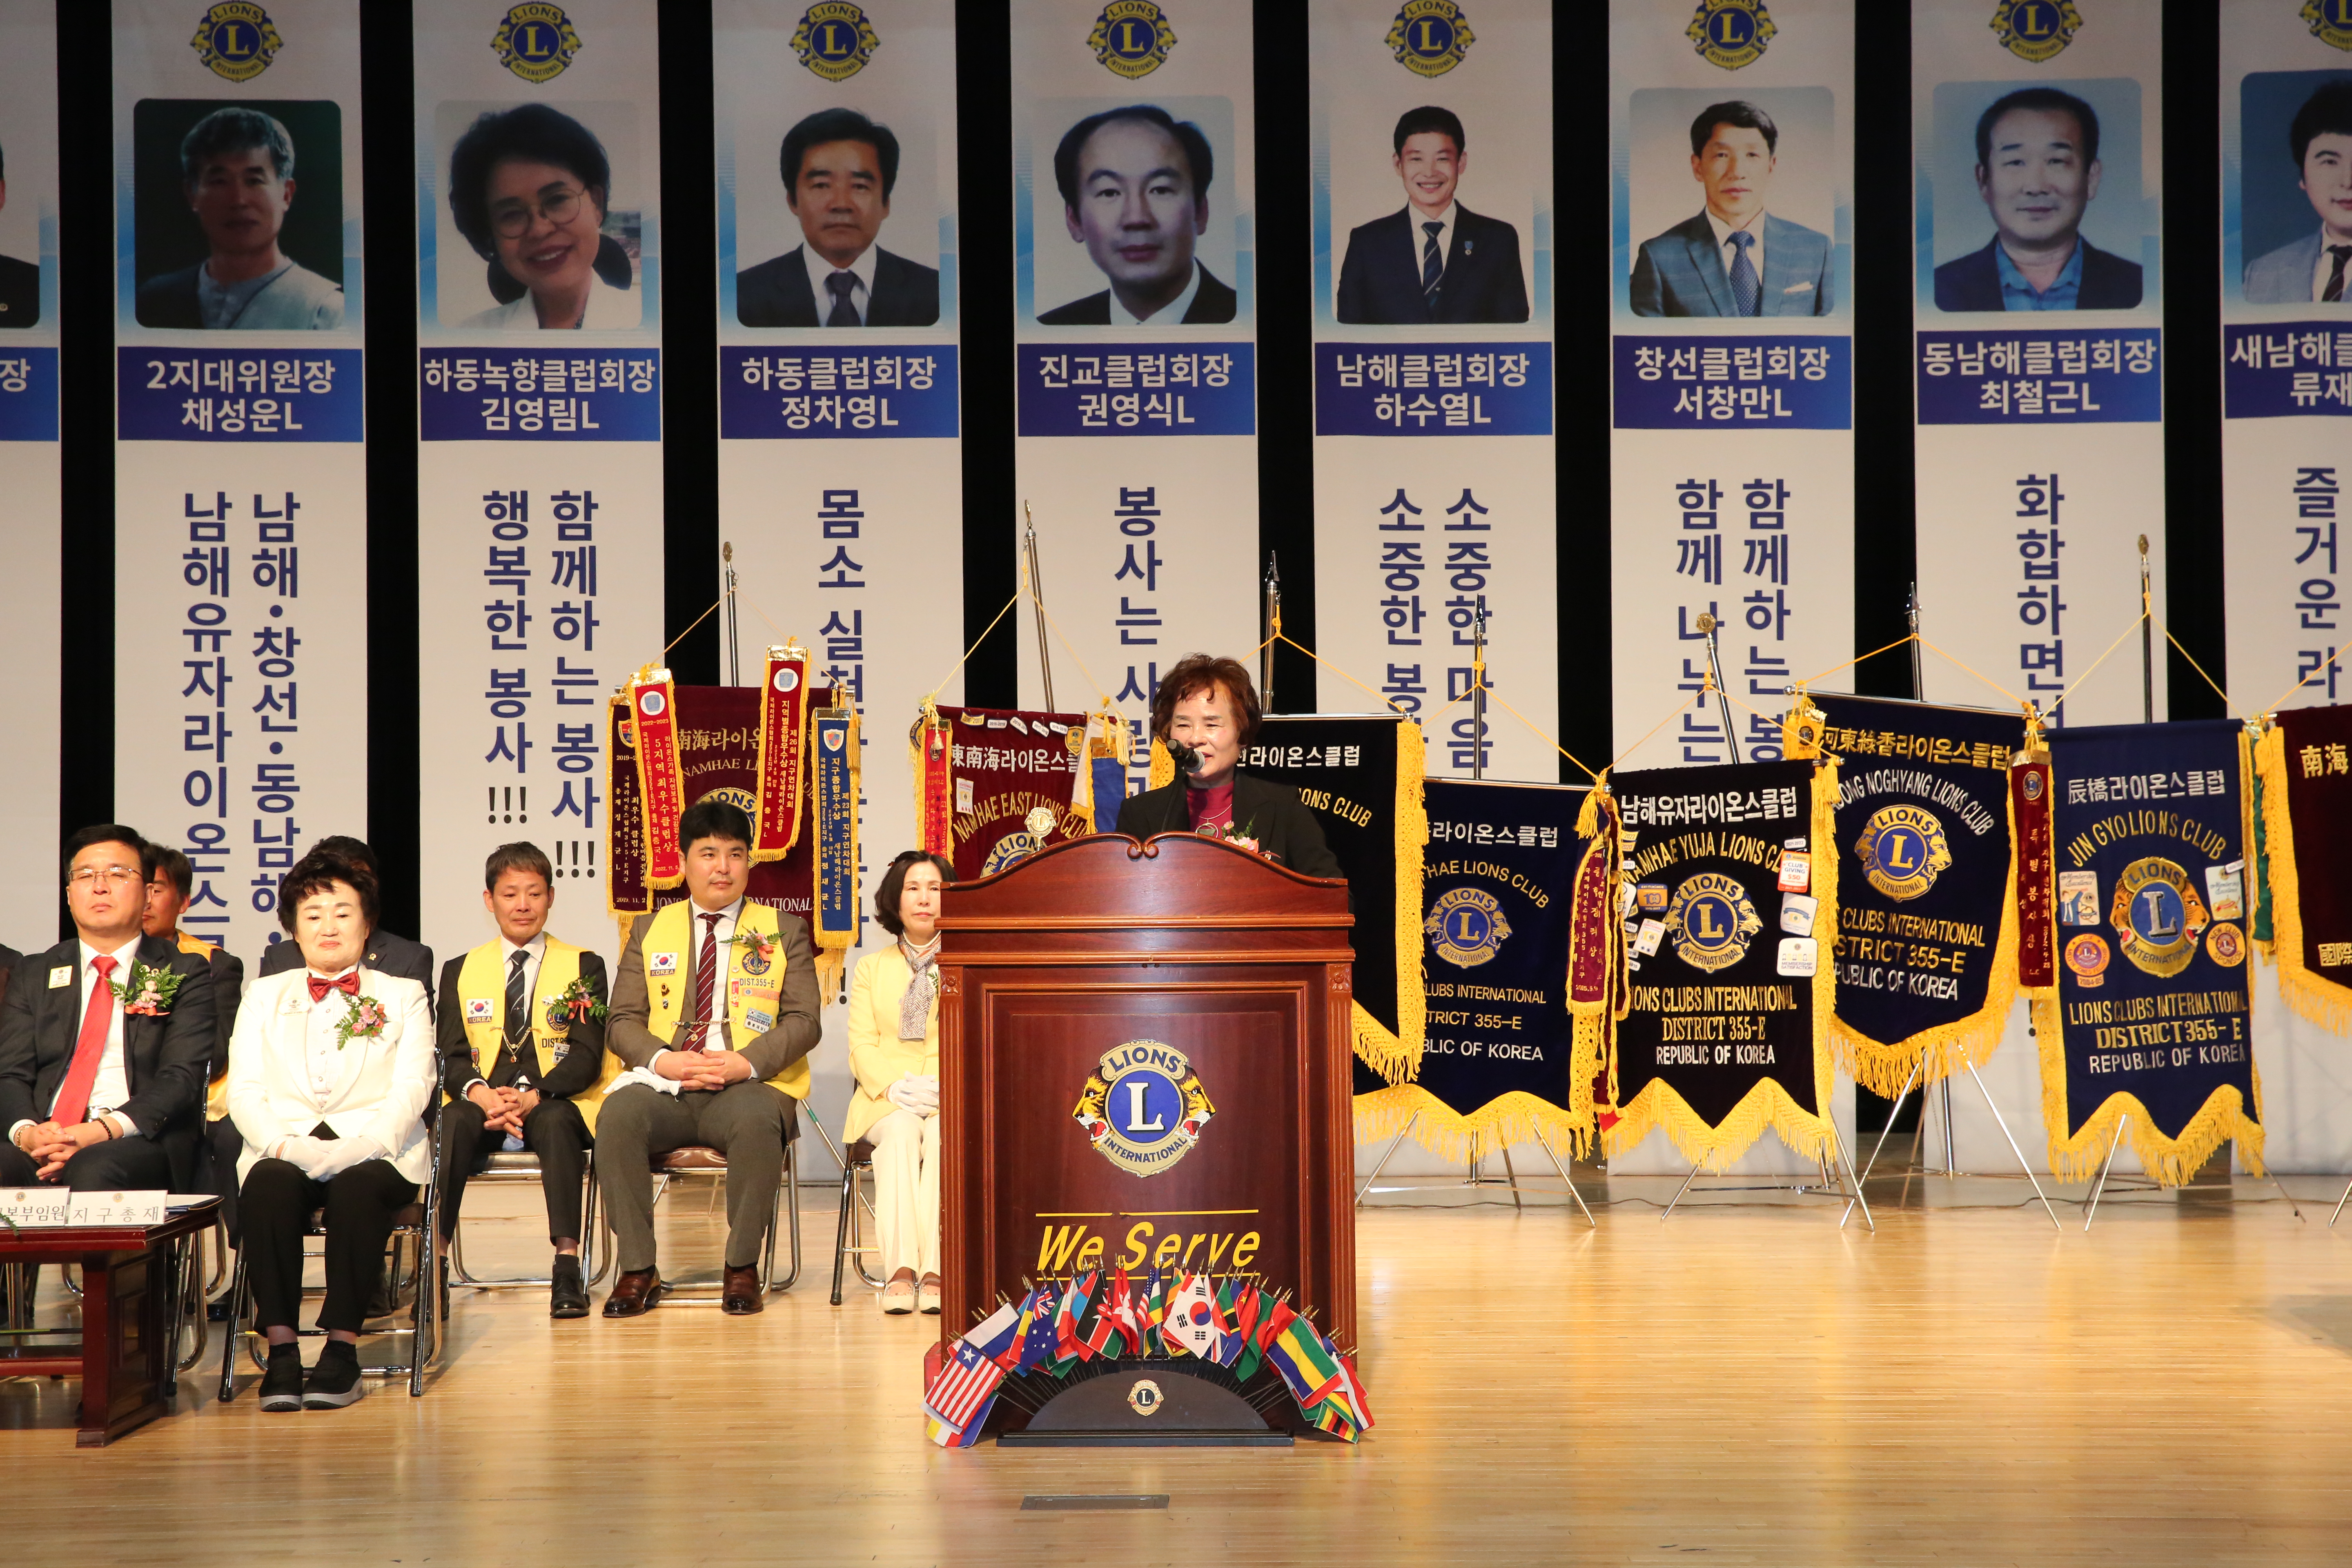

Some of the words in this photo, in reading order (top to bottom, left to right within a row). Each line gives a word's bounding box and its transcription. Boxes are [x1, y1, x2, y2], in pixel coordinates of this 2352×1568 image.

[213, 5, 260, 20] LIONS
[513, 6, 559, 21] LIONS
[812, 4, 857, 21] LIONS
[1109, 3, 1154, 19] LIONS
[1408, 1, 1453, 16] LIONS
[2025, 5, 2049, 35] L
[225, 25, 249, 55] L
[525, 27, 548, 56] L
[823, 25, 847, 55] L
[1120, 24, 1144, 52] L
[1419, 21, 1443, 51] L
[1720, 13, 1744, 42] L
[213, 60, 261, 76] INTERNATIONAL
[513, 62, 560, 76] INTERNATIONAL
[813, 60, 859, 76] INTERNATIONAL
[1110, 58, 1156, 74] INTERNATIONAL
[1408, 56, 1454, 72] INTERNATIONAL
[742, 356, 936, 390] 하동클럽회장
[1040, 354, 1233, 388] 진교클럽회장
[1337, 354, 1530, 388] 남해클럽회장
[1635, 347, 1831, 381] 창선클럽회장
[1923, 339, 2156, 376] 동남해클럽회장
[147, 360, 335, 393] 2지대위원장
[425, 360, 656, 394] 하동녹향클럽회장
[2290, 372, 2352, 407] 류재
[781, 394, 899, 428] 정차영L
[1078, 393, 1195, 427] 권영식L
[1374, 392, 1492, 426] 하수열L
[1673, 386, 1793, 420] 서창만L
[1980, 380, 2100, 414] 최철근L
[182, 399, 303, 432] 채성운L
[481, 398, 599, 432] 김영림L
[817, 490, 865, 588] 몸소
[1675, 479, 1724, 585] 함께
[2293, 467, 2341, 629] 즐거운
[483, 490, 532, 650] 행복한
[1114, 486, 1163, 645] 봉사는
[1379, 488, 1426, 646] 소중한
[1444, 488, 1492, 646] 소중한
[550, 490, 600, 705] 함께하는
[1742, 479, 1791, 695] 함께하는
[1677, 601, 1725, 763] 나누는
[1447, 664, 1494, 769] 마음
[780, 700, 790, 768] 지역별종합우수상
[789, 729, 797, 755] 제26회
[654, 739, 665, 773] 5지역
[684, 758, 740, 779] NAMHAE
[2300, 743, 2349, 778] 南海
[786, 760, 796, 808] 지구연차대회
[831, 757, 841, 820] 지구종합우수상
[2068, 769, 2226, 805] 辰橋라이온스클럽
[631, 797, 639, 824] 최우수
[657, 777, 673, 852] 최우수클럽상
[1001, 791, 1032, 817] EAST
[1333, 797, 1372, 828] CLUB
[1621, 786, 1797, 826] 남해유자라이온스클럽
[1866, 768, 1933, 799] NOGHYANG
[1931, 778, 1969, 813] LIONS
[1960, 800, 1995, 836] CLUB
[1036, 815, 1045, 828] L
[1877, 809, 1934, 831] LIONS
[630, 830, 639, 857] 클럽상
[842, 823, 851, 876] 지구연차대회
[1889, 834, 1914, 869] L
[2067, 832, 2097, 867] JIN
[2092, 814, 2127, 846] GYO
[2128, 809, 2179, 838] LIONS
[2181, 818, 2227, 860] CLUB
[1622, 838, 1678, 884] NAMHAE
[1678, 832, 1715, 860] YUJA
[1719, 832, 1765, 865] LIONS
[1464, 860, 1510, 882] LIONS
[1512, 874, 1550, 908] CLUB
[1684, 875, 1738, 898] LIONS
[1872, 873, 1925, 894] INTERNATIONAL
[2127, 863, 2182, 888] LIONS
[1447, 890, 1494, 908] LIONS
[2142, 891, 2178, 938] L
[1457, 912, 1479, 940] L
[1697, 904, 1724, 938] L
[1842, 907, 1885, 933] CLUBS
[1888, 912, 1986, 948] INTERNATIONAL
[2209, 927, 2222, 939] NEW
[2224, 925, 2241, 939] CLUB
[1442, 947, 1490, 963] INTERNATIONAL
[1682, 946, 1741, 965] INTERNATIONAL
[1906, 944, 1967, 974] 355-E
[2127, 940, 2194, 964] INTERNATIONAL
[2213, 950, 2243, 965] SPONSOR
[739, 978, 775, 988] DIST.355-E
[1457, 984, 1546, 1004] INTERNATIONAL
[1662, 986, 1702, 1012] CLUBS
[1703, 984, 1797, 1012] INTERNATIONAL
[1888, 969, 1905, 992] OF
[1909, 972, 1958, 1001] KOREA
[2069, 1000, 2113, 1025] LIONS
[2114, 997, 2155, 1022] CLUBS
[2157, 990, 2249, 1018] INTERNATIONAL
[1662, 1016, 1726, 1041] DISTRICT
[1729, 1016, 1766, 1041] 355-E
[2095, 1021, 2183, 1049] DISTRICT
[1106, 1046, 1183, 1074] LIONS
[1460, 1041, 1482, 1056] OF
[1488, 1044, 1544, 1061] KOREA
[1656, 1045, 1709, 1065] REPUBLIC
[1715, 1045, 1731, 1065] OF
[1736, 1044, 1776, 1065] KOREA
[2089, 1049, 2165, 1074] REPUBLIC
[2172, 1047, 2192, 1067] OF
[2199, 1043, 2246, 1064] KOREA
[1125, 1082, 1165, 1131] L
[1103, 1135, 1187, 1164] INTERNATIONAL
[1036, 1225, 1105, 1272] We
[1121, 1221, 1261, 1272] Serve
[1141, 1390, 1151, 1404] L
